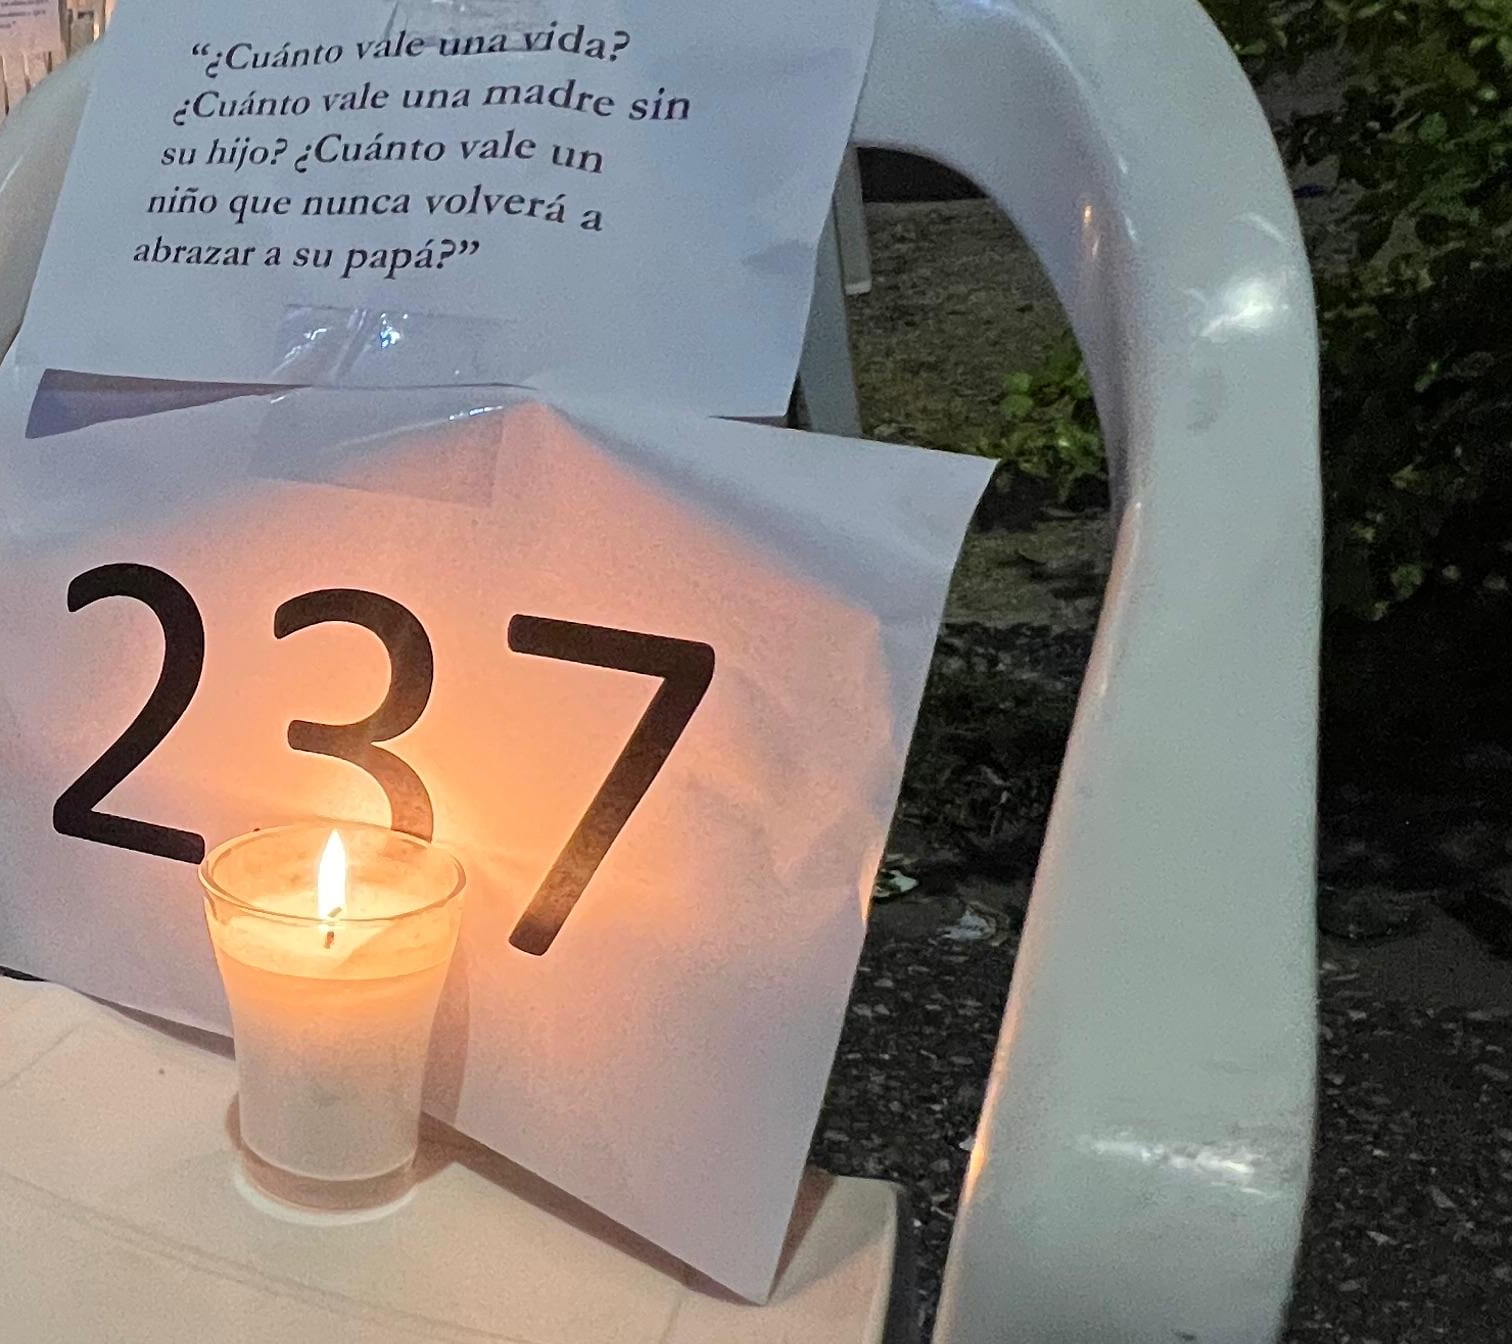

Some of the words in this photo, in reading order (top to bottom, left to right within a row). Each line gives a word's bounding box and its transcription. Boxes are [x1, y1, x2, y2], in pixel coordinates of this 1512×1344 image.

[191, 38, 343, 77] “¿Cuánto
[354, 28, 426, 61] vale
[437, 30, 509, 56] una
[522, 19, 631, 63] vida?
[172, 90, 310, 125] ¿Cuánto
[322, 82, 389, 114] vale
[402, 85, 471, 110] una
[481, 77, 616, 118] madre
[628, 86, 691, 123] sin
[160, 142, 197, 167] su
[206, 135, 287, 172] hijo?
[294, 132, 446, 173] ¿Cuánto
[459, 128, 537, 161] vale
[551, 143, 604, 175] un
[146, 186, 218, 217] niño
[227, 192, 292, 226] que
[301, 188, 410, 218] nunca
[425, 183, 567, 226] volverá
[579, 208, 604, 234] a
[132, 236, 256, 269] abrazar
[263, 245, 281, 269] a
[292, 242, 333, 270] su
[342, 237, 481, 281] papá?”
[51, 561, 716, 958] 237
